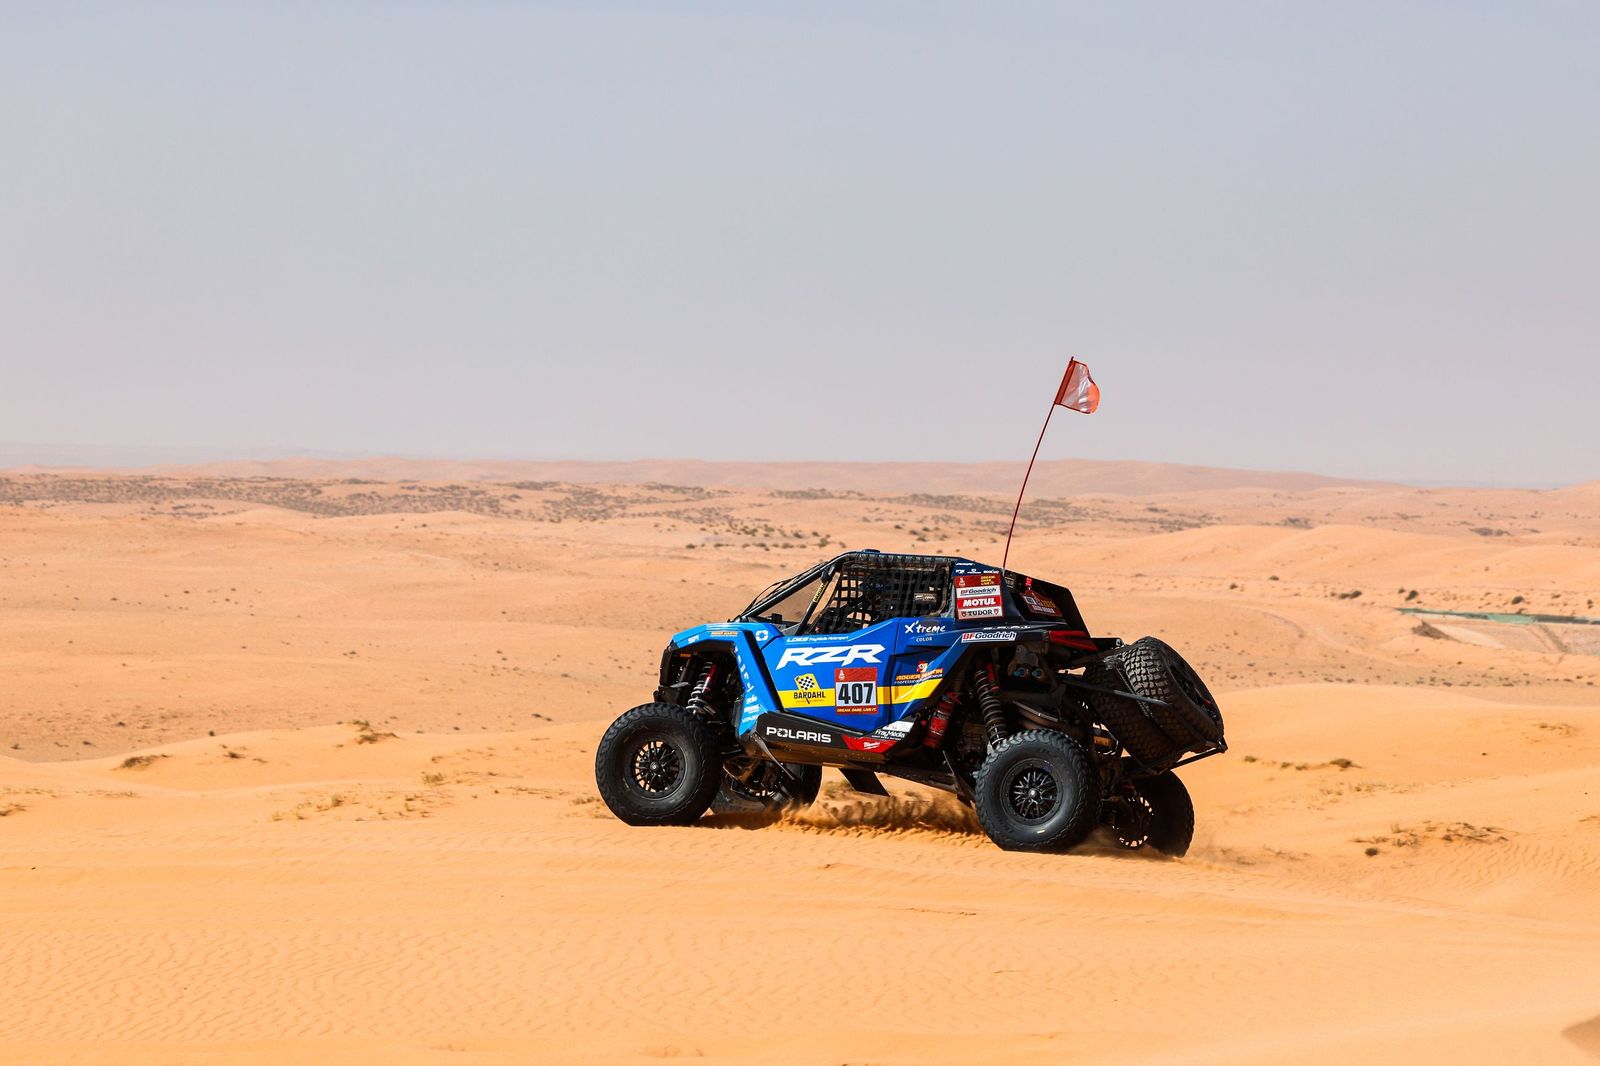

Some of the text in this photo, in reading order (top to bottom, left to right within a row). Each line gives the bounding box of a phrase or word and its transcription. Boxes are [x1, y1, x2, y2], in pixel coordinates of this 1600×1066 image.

[963, 598, 996, 607] MOTUL
[968, 609, 993, 617] TUDOR
[962, 632, 1016, 640] BFGoodrich
[775, 644, 886, 671] RZR
[895, 673, 921, 681] ROGER
[793, 691, 827, 704] BARDAHL
[838, 682, 874, 705] 407
[766, 726, 832, 743] POLARIS
